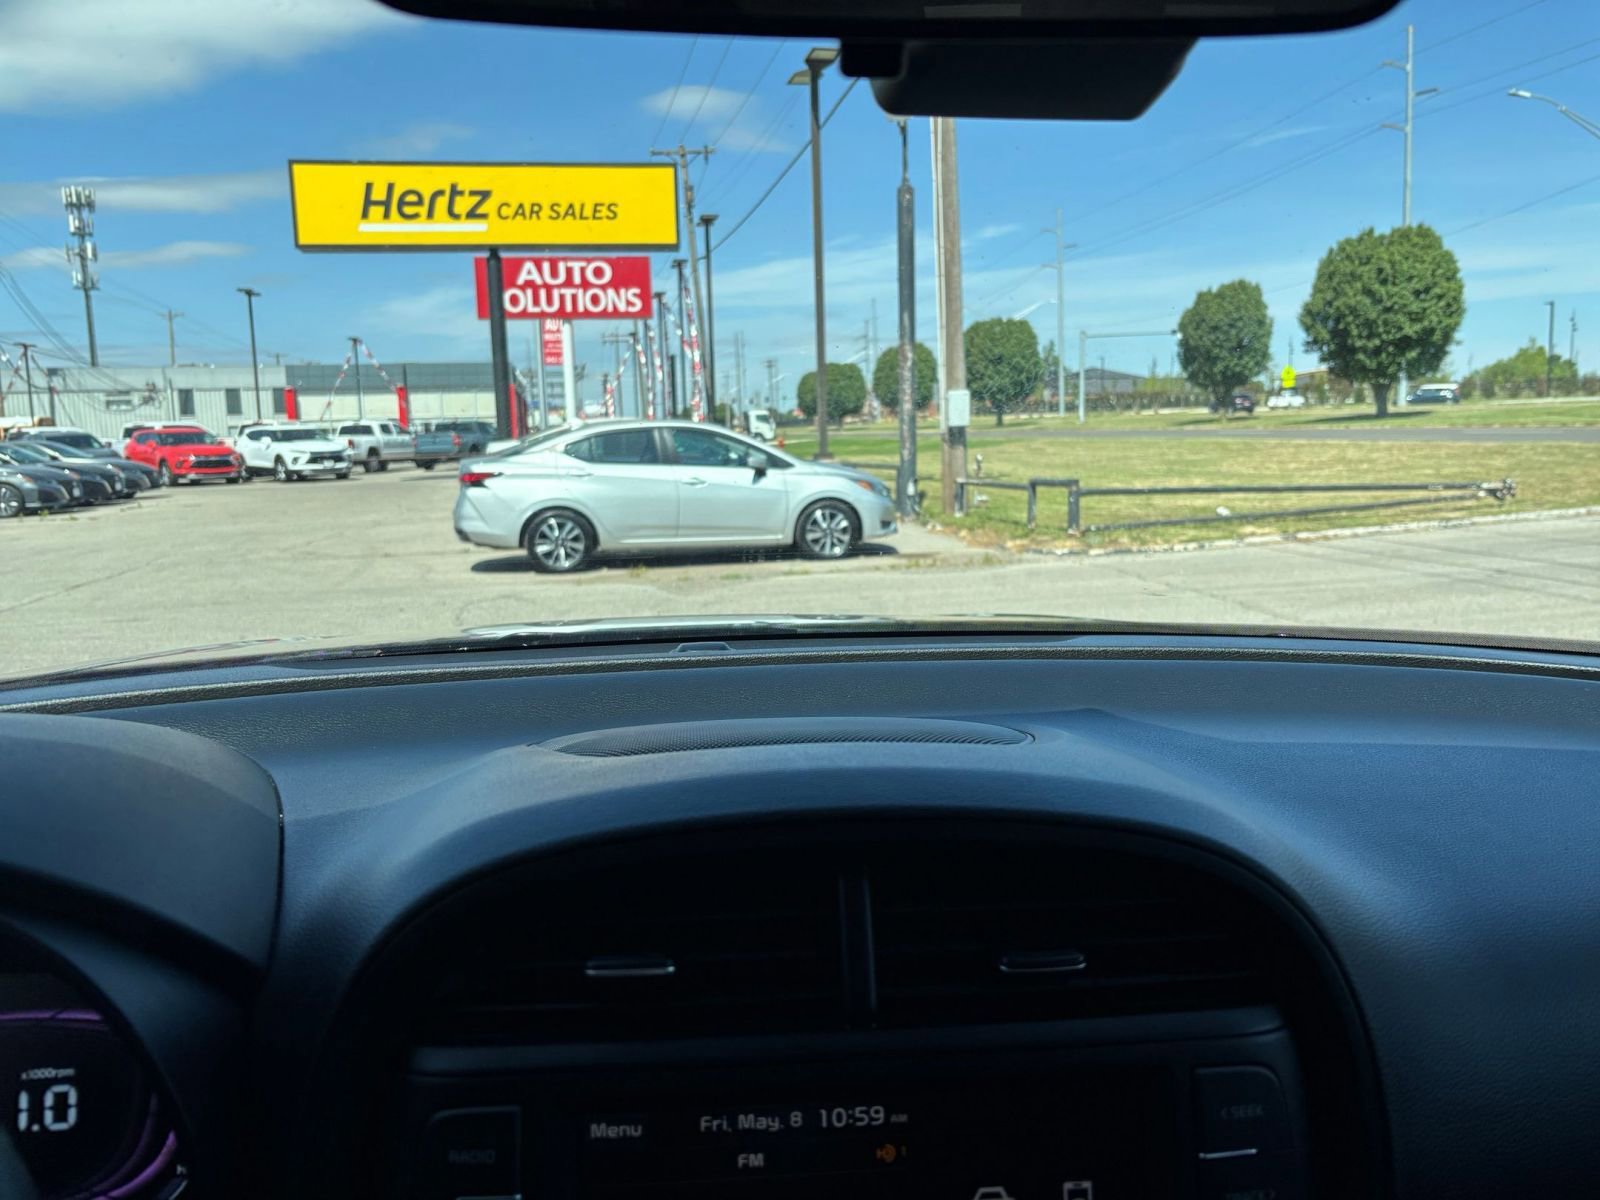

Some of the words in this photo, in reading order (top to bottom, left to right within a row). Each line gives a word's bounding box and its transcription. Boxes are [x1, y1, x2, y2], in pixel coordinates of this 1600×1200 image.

[361, 181, 492, 220] Hertz
[497, 202, 542, 220] CAR
[548, 202, 618, 220] SALES
[515, 260, 613, 285] AUTO
[503, 287, 643, 313] OLUTIONS
[16, 1083, 78, 1133] 1.0
[789, 1110, 804, 1127] 8
[819, 1105, 886, 1129] 10:59
[590, 1122, 643, 1138] Menu
[736, 1152, 765, 1169] FM
